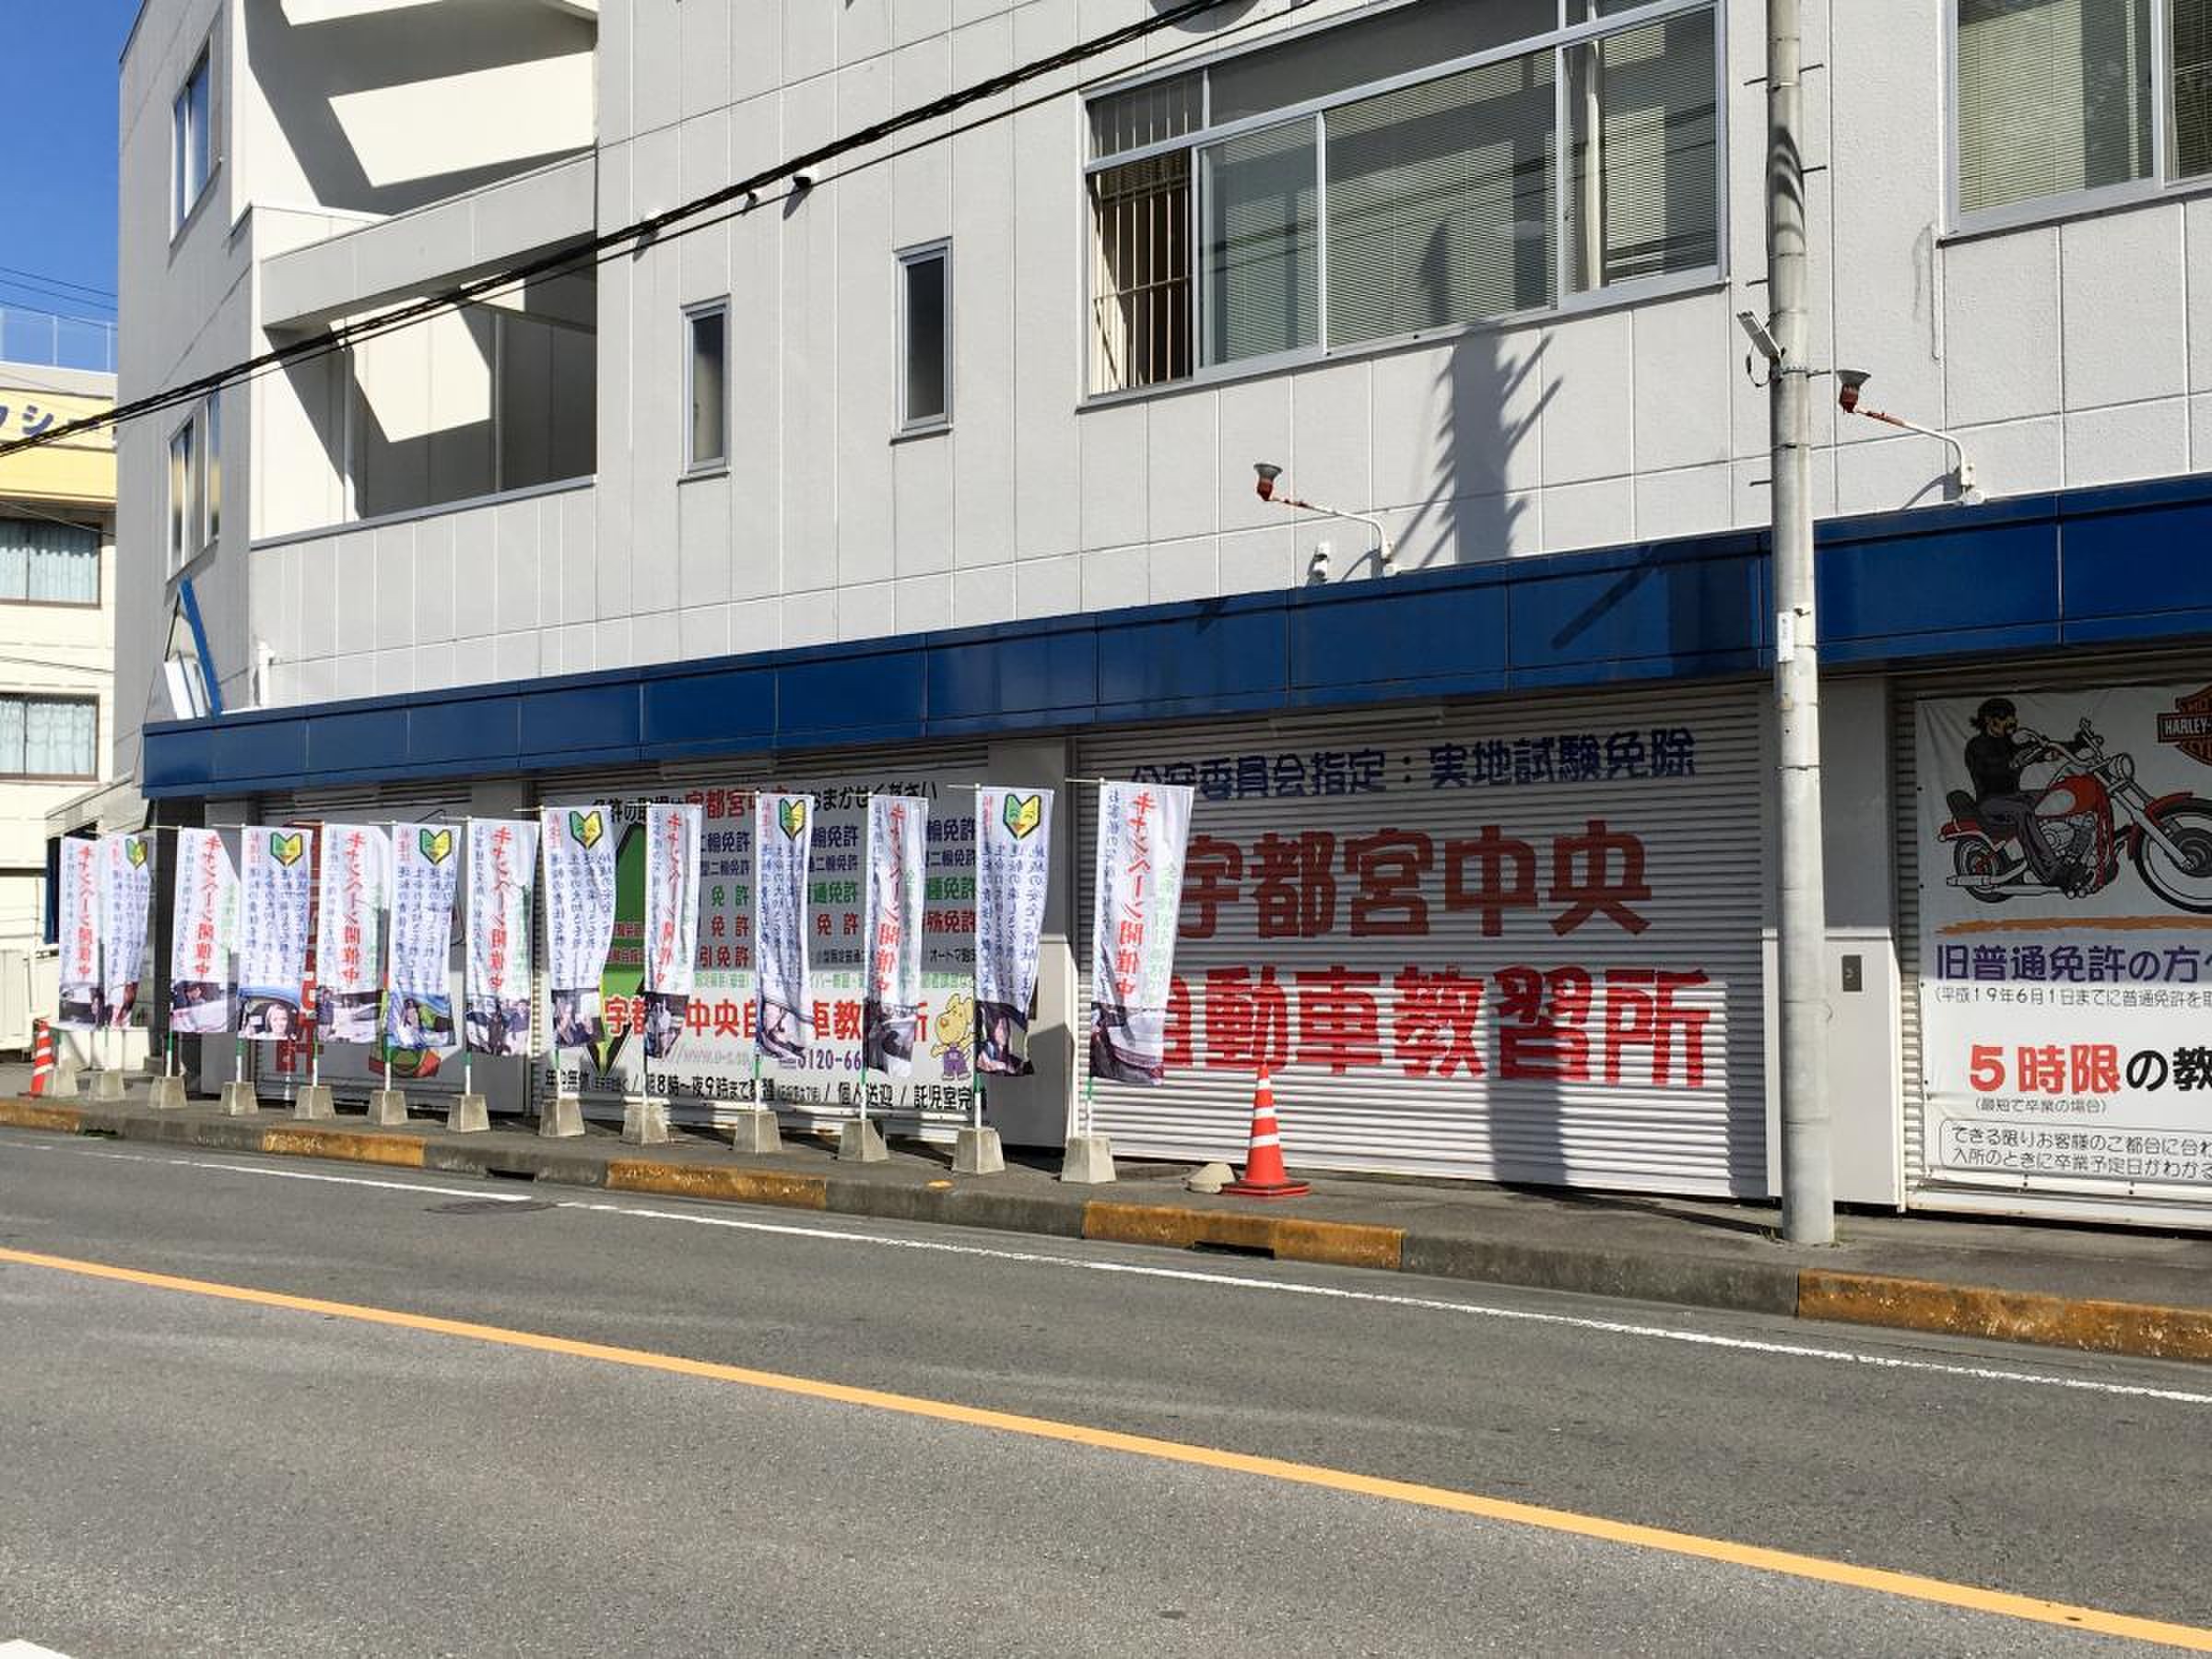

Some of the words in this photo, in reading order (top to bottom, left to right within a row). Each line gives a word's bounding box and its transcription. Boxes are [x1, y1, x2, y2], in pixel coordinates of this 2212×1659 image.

[1178, 819, 1652, 939] 宇都宮中央
